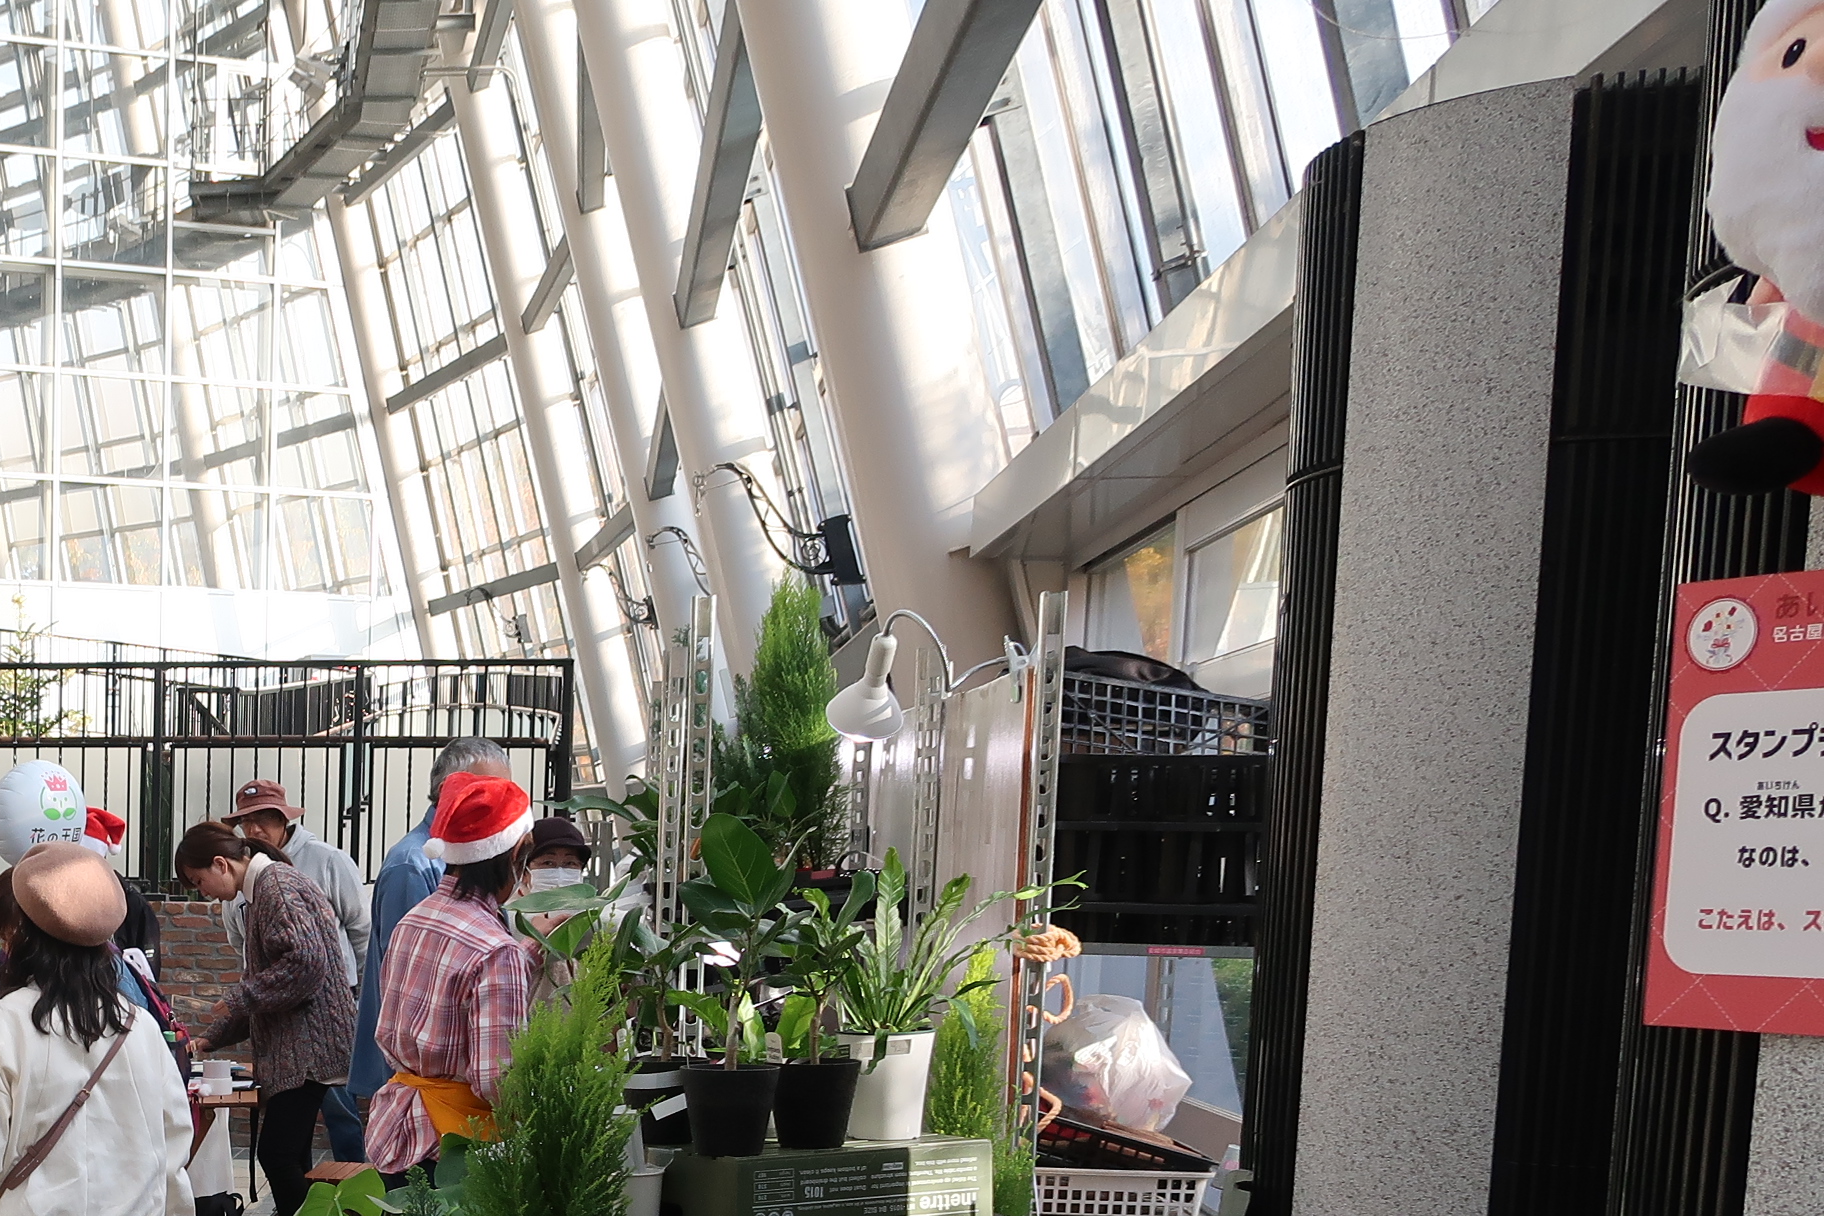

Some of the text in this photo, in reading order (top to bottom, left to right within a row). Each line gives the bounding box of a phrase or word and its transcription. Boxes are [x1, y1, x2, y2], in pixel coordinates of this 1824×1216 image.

[1773, 624, 1824, 643] 名古屋
[1708, 721, 1824, 761] スタンプ
[1704, 793, 1824, 823] Q. 愛知県
[1737, 845, 1810, 868] なのは、
[804, 1186, 824, 1198] 1015
